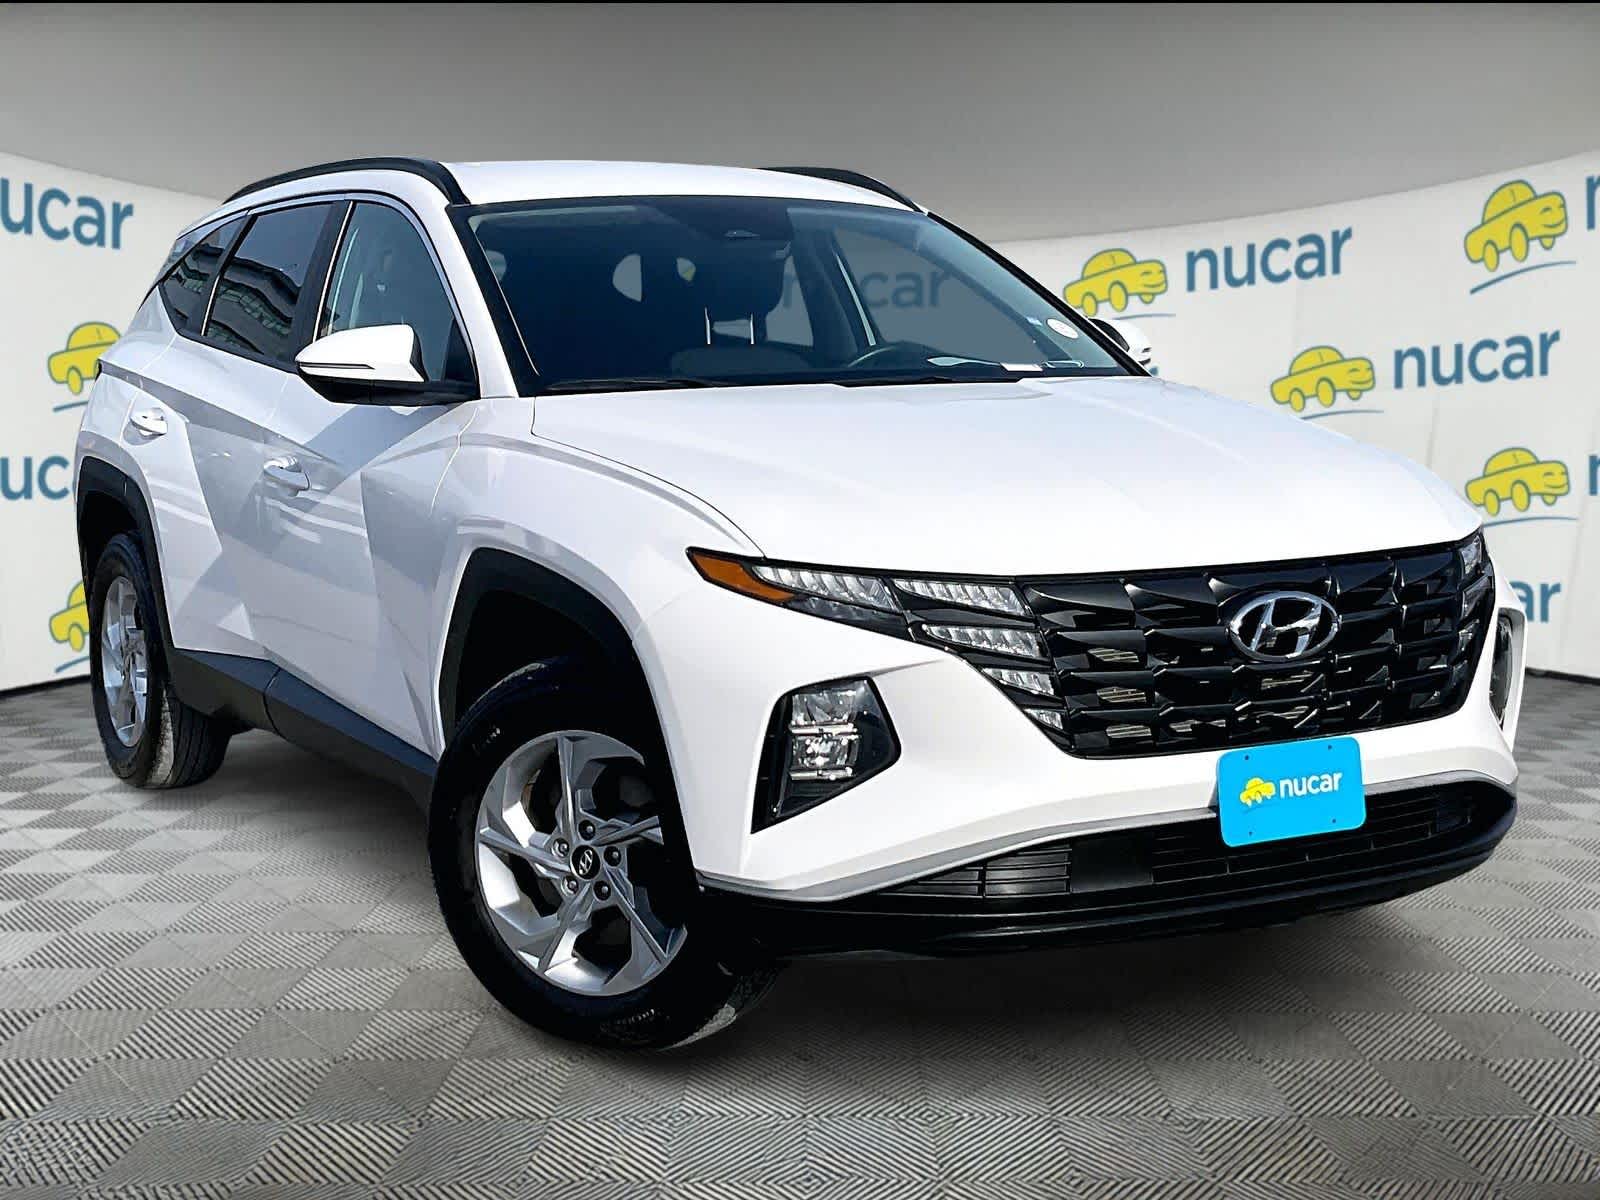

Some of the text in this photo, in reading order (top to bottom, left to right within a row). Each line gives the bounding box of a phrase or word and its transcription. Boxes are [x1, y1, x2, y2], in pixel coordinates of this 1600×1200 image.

[1186, 226, 1353, 293] nucar
[1394, 329, 1561, 390] nucar
[0, 455, 76, 501] uc
[1279, 772, 1343, 799] nucar
